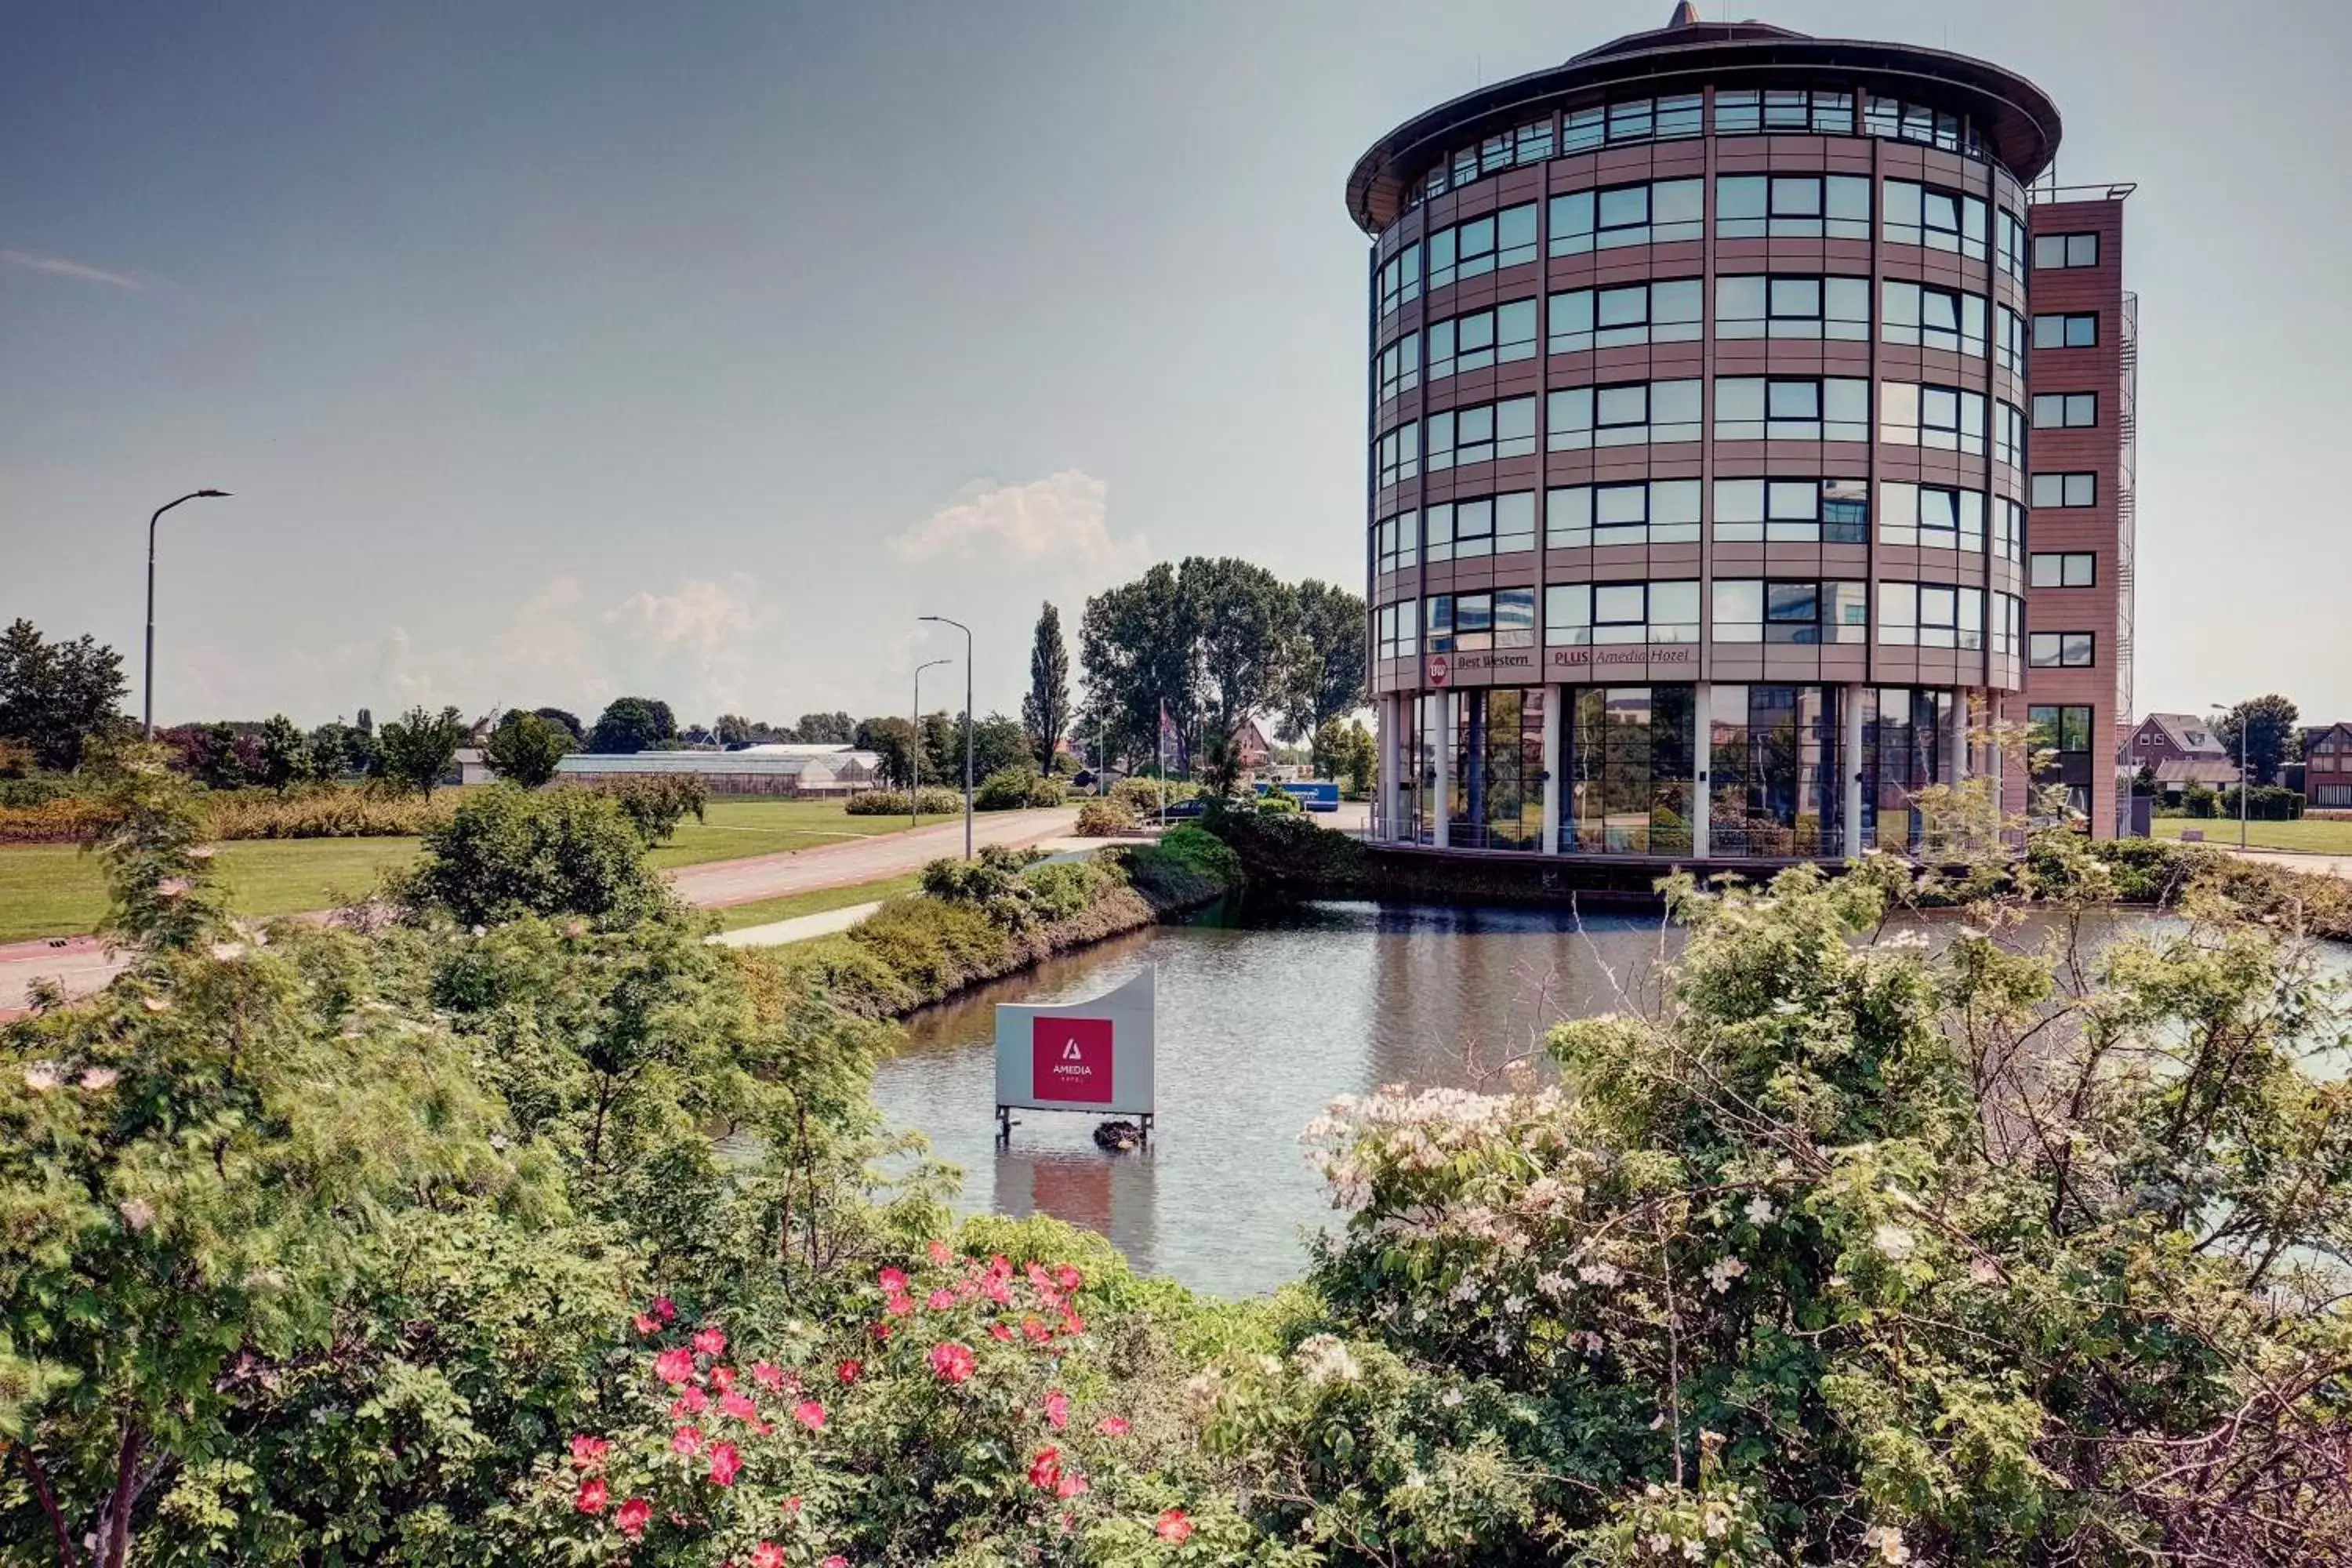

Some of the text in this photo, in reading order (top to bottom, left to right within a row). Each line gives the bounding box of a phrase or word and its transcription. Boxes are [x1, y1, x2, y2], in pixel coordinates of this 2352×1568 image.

[1459, 648, 1690, 667] Best Western PLUS Amedia Hotel
[1053, 1065, 1092, 1075] AMEDIA
